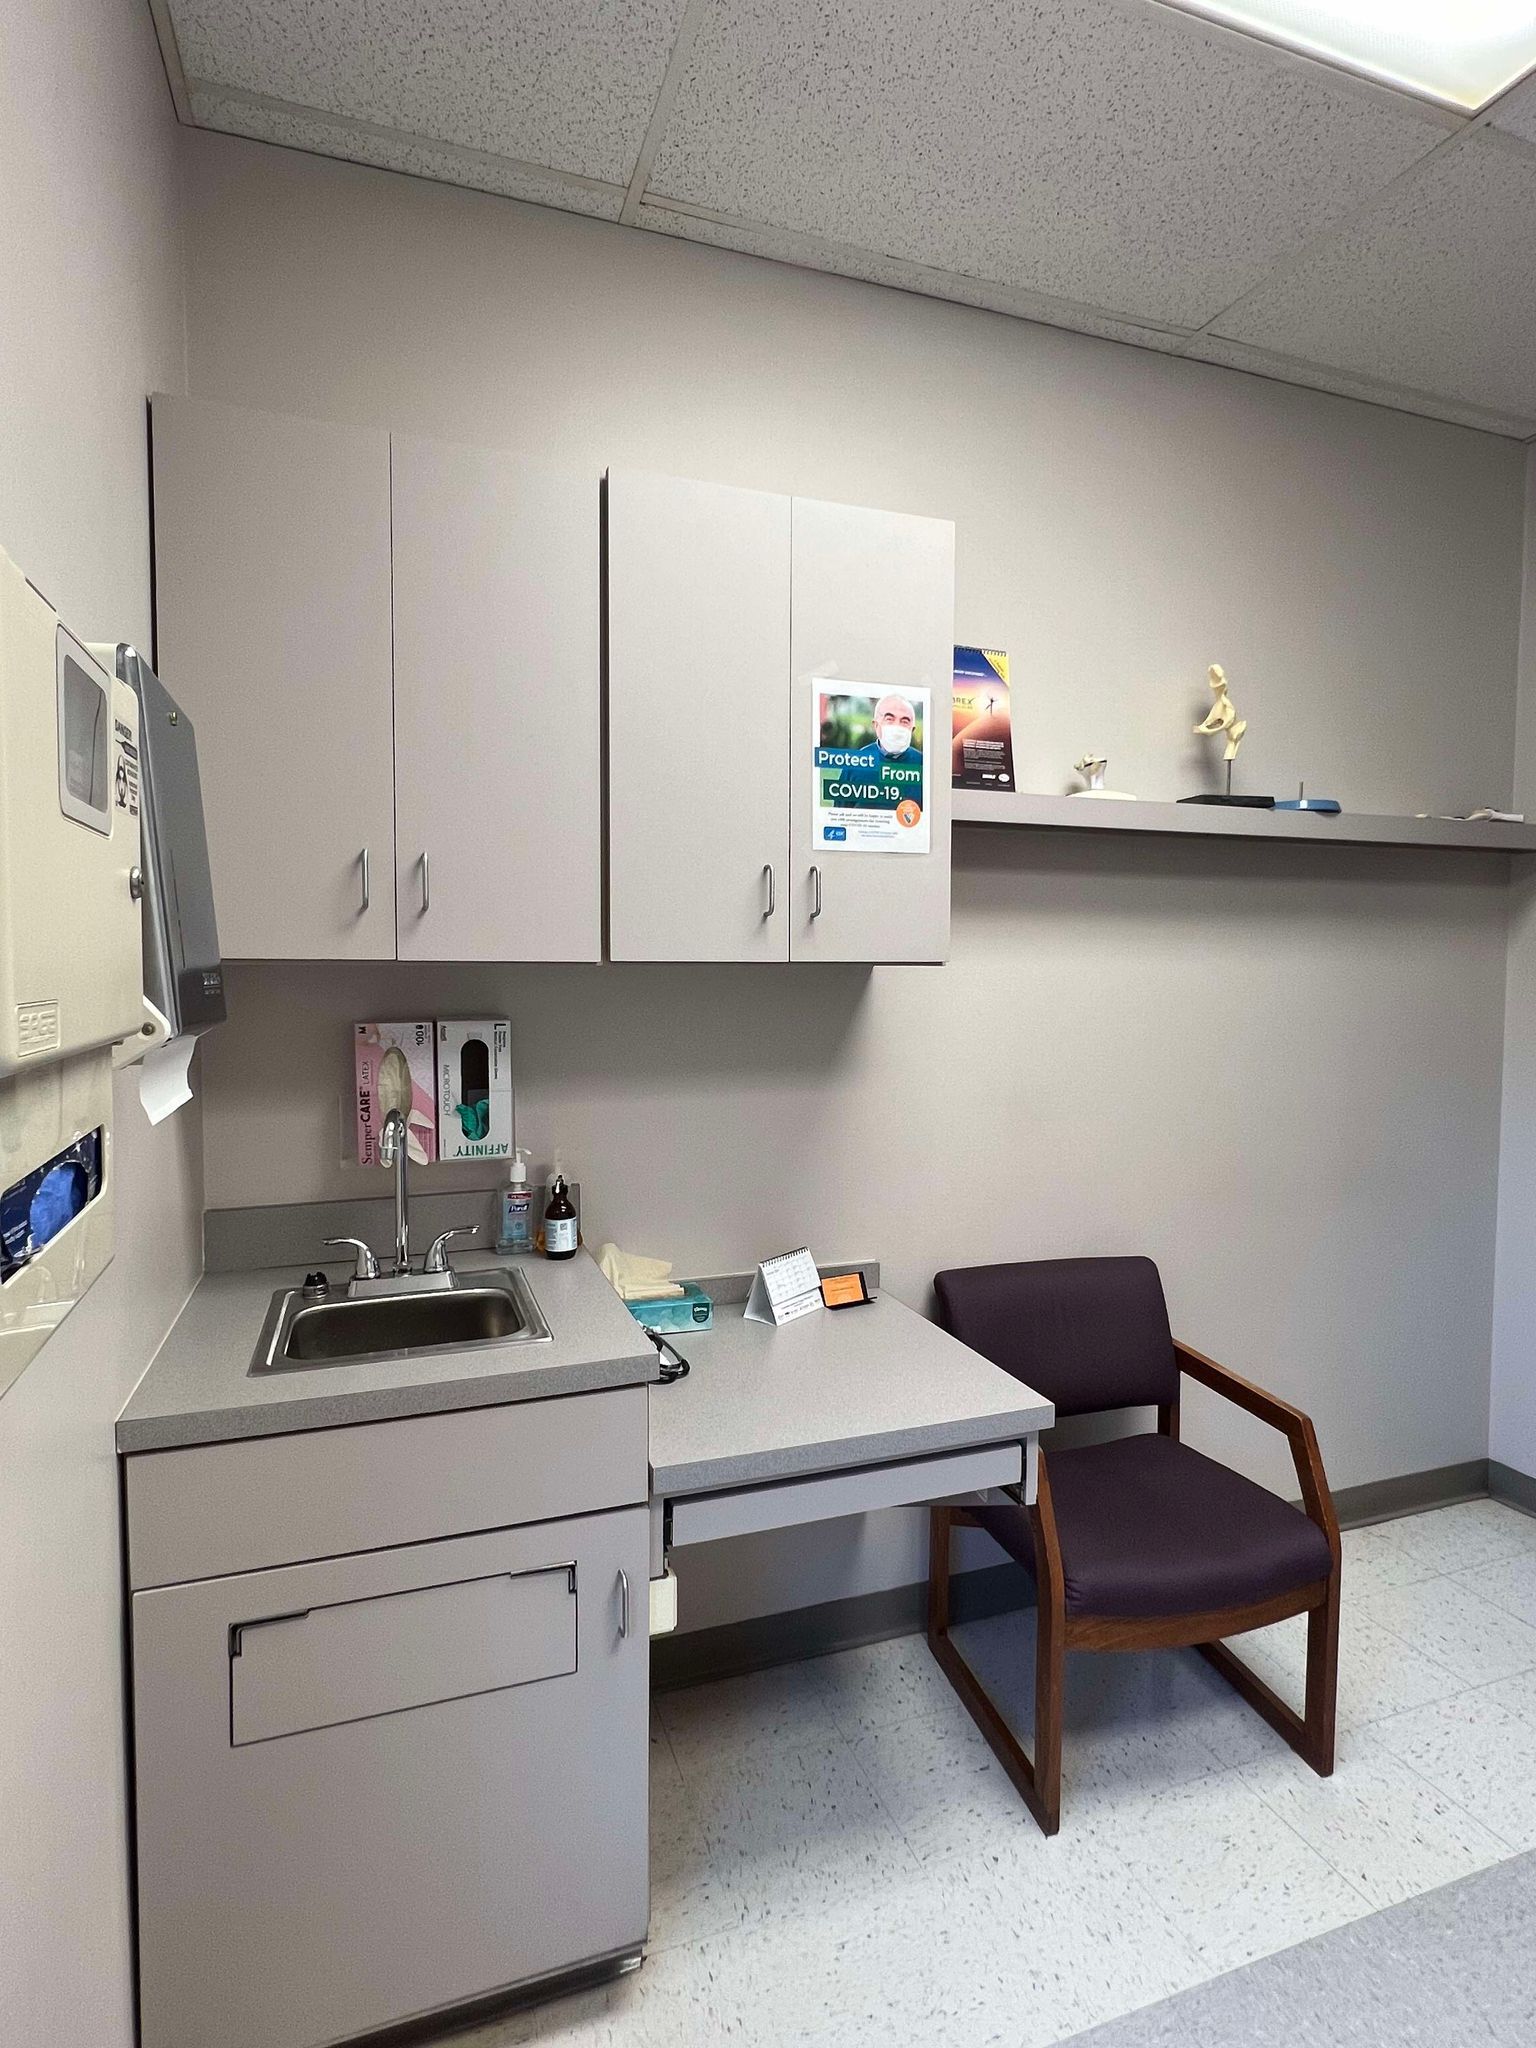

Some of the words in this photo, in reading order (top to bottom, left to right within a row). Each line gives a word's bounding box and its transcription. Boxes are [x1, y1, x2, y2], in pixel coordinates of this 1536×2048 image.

[818, 750, 875, 768] Protect
[881, 766, 921, 782] From
[828, 783, 903, 801] COVID-19.
[358, 1026, 367, 1034] M
[362, 1061, 370, 1085] LATEX
[456, 1143, 509, 1157] AFFINITY
